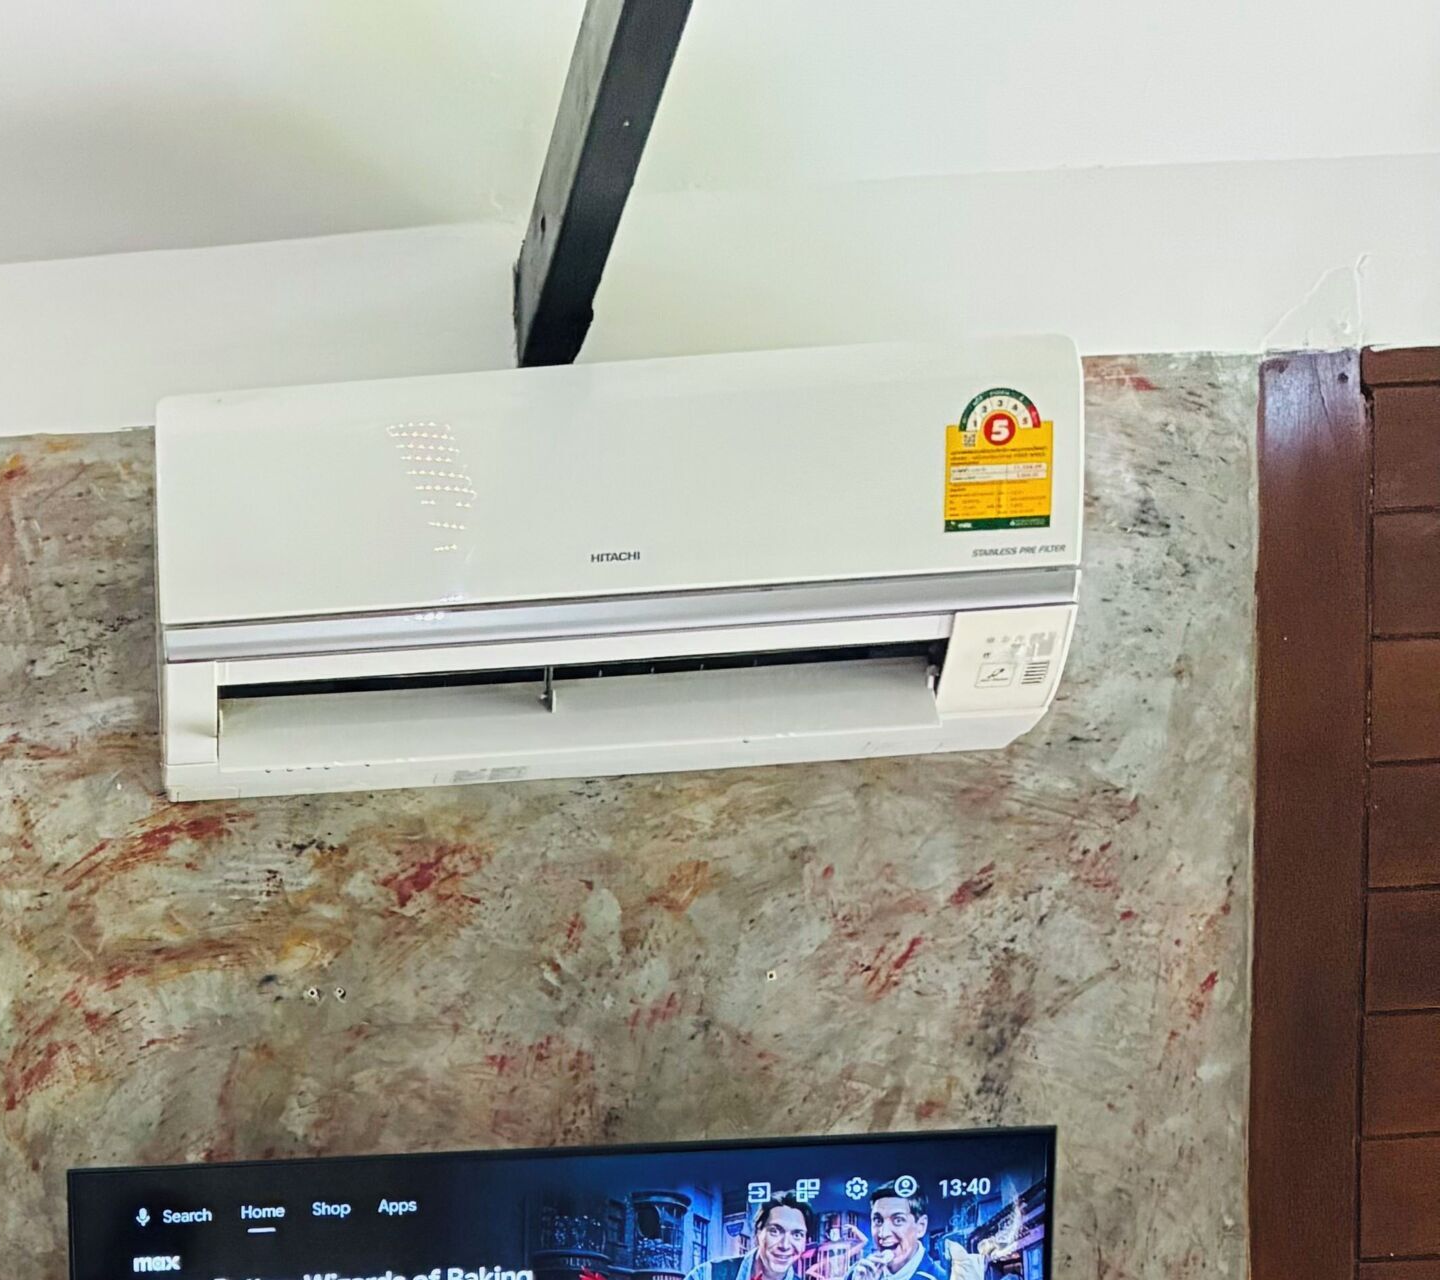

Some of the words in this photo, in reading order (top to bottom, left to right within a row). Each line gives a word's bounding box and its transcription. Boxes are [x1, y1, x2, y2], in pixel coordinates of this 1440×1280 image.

[997, 399, 1003, 407] 3
[991, 418, 1010, 441] 5
[591, 551, 641, 563] HITACHI
[939, 1177, 991, 1198] 13:40
[240, 1204, 286, 1219] Home
[312, 1200, 351, 1218] Shop
[377, 1198, 418, 1215] Apps
[162, 1207, 213, 1224] Search
[133, 1255, 181, 1272] max
